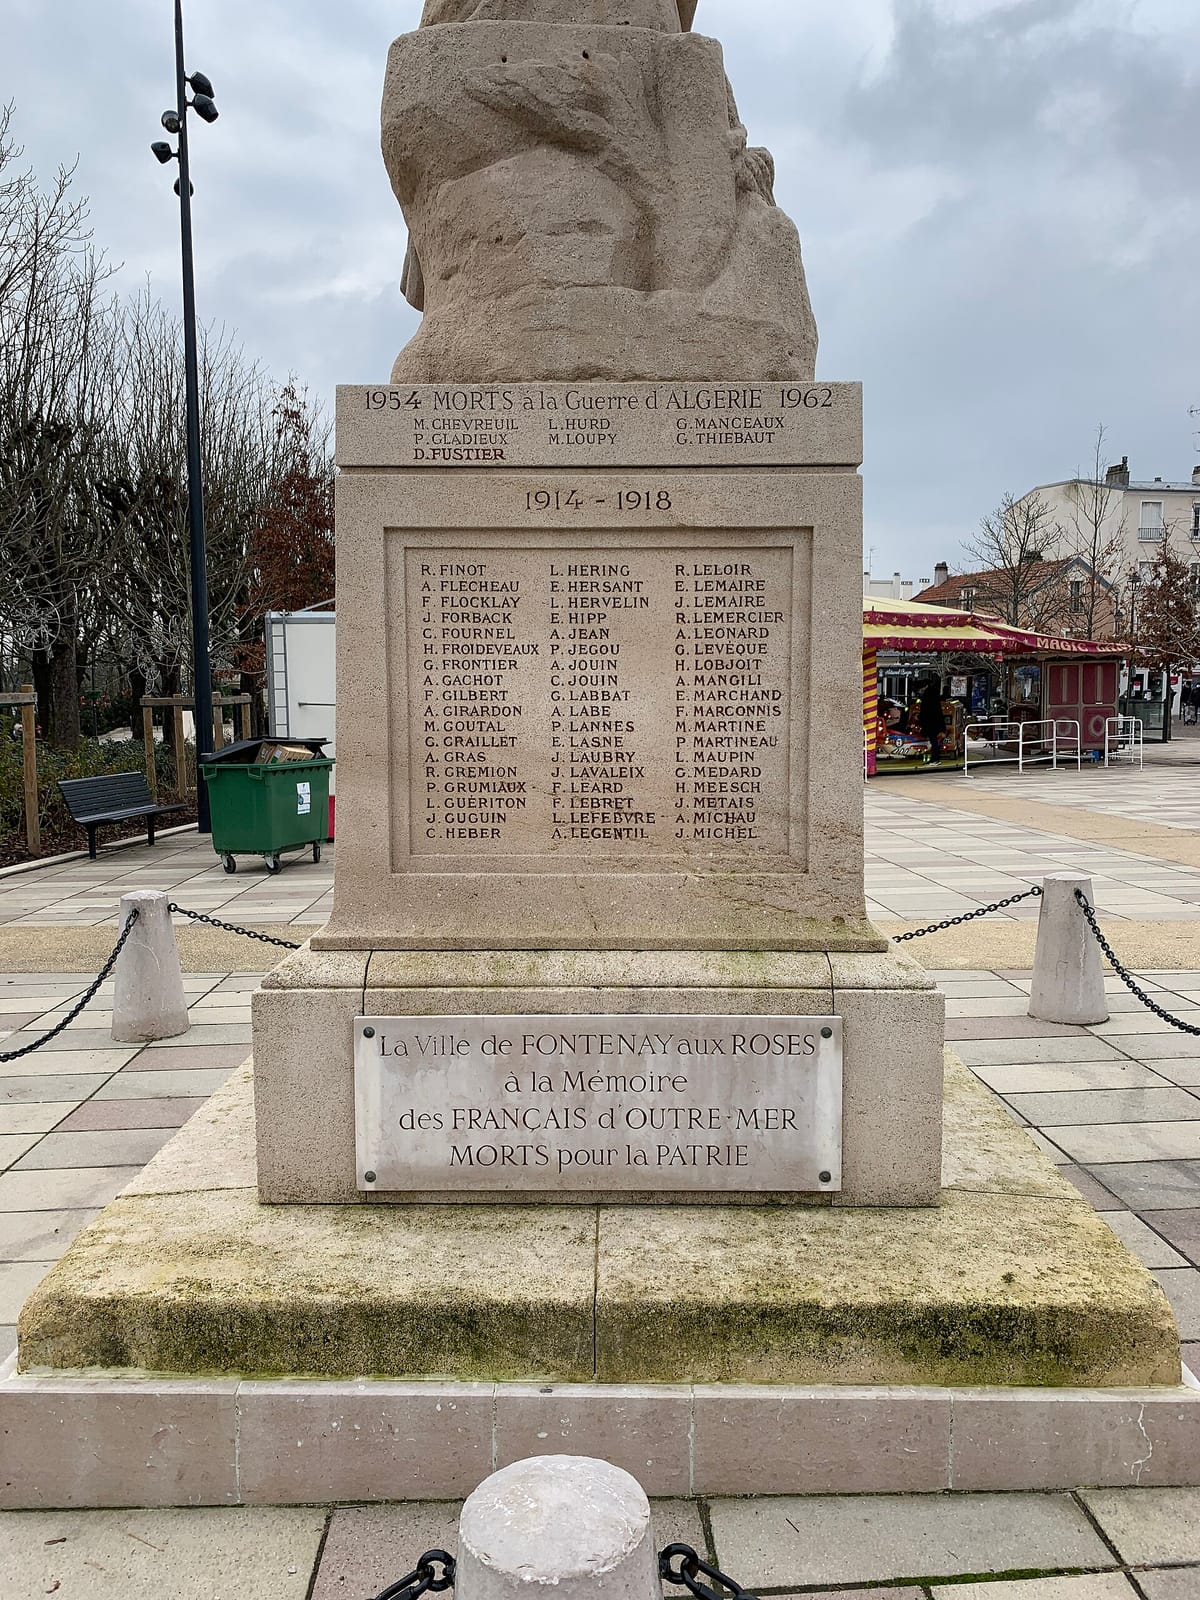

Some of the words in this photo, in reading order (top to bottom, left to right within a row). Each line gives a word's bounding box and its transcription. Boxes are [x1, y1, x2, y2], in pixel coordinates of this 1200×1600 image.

[365, 390, 422, 410] 1954
[433, 391, 514, 410] MORTS
[540, 391, 558, 410] la
[565, 391, 639, 410] Guerre
[780, 388, 833, 409] 1962
[525, 490, 584, 511] 1914
[616, 490, 672, 511] 1918
[1036, 637, 1089, 652] MAGIC
[380, 1035, 409, 1057] La
[415, 1035, 471, 1057] Ville
[481, 1035, 513, 1056] de
[521, 1034, 674, 1056] FONTENAY
[677, 1037, 726, 1056] aux
[731, 1034, 816, 1056] ROSES
[504, 1071, 522, 1093] à
[531, 1071, 554, 1093] la
[562, 1069, 688, 1093] Mémoire
[399, 1109, 444, 1130] des
[452, 1107, 588, 1133] FRANÇAIS
[449, 1145, 550, 1166] MORTS
[557, 1148, 619, 1174] pour
[625, 1145, 650, 1166] la
[656, 1145, 749, 1166] PATRIE
